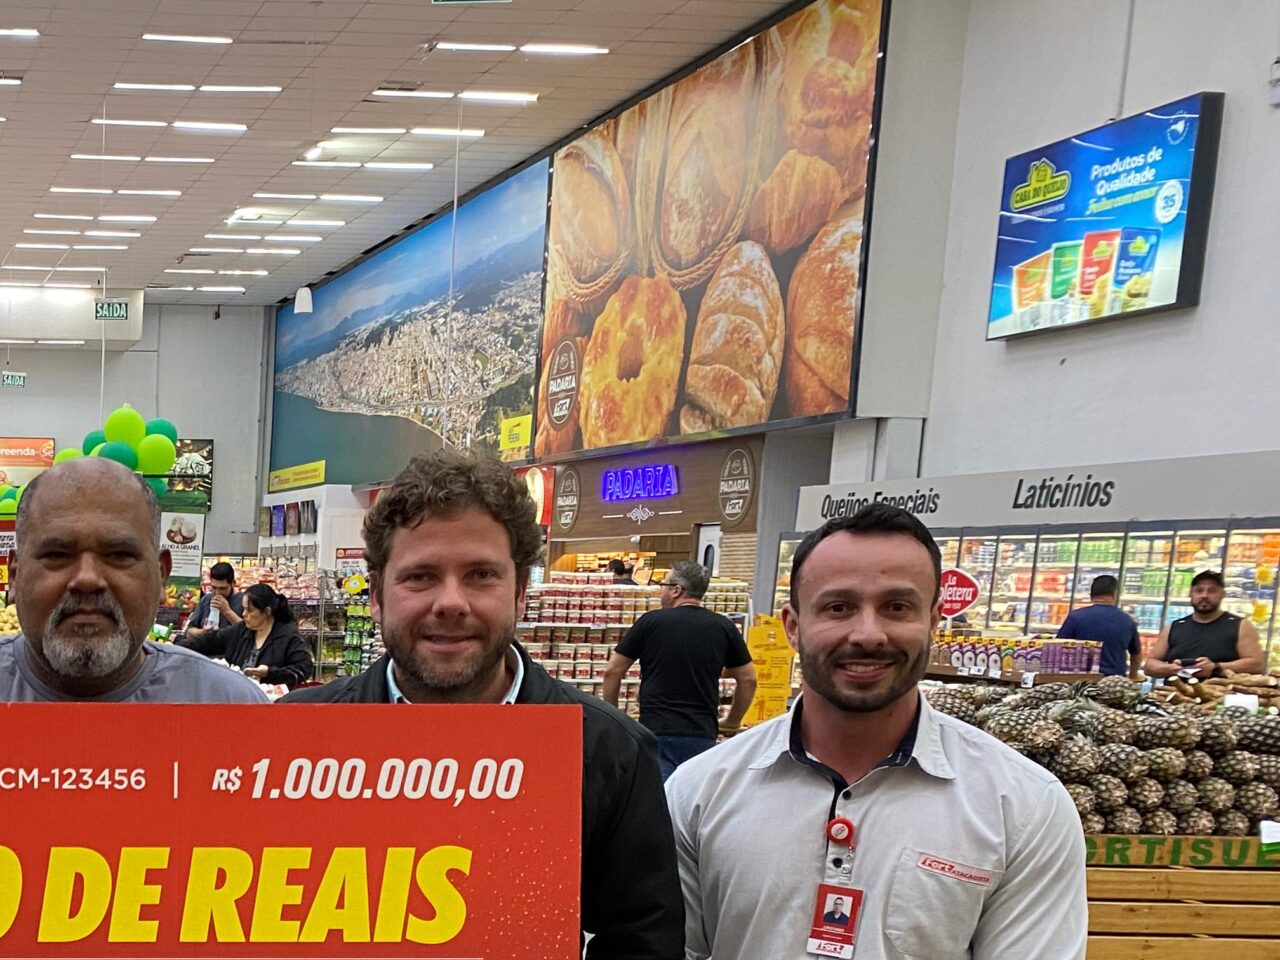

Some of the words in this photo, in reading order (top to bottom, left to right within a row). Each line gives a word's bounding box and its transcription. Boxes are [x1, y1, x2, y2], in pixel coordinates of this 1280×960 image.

[1090, 153, 1144, 180] Produtos
[1147, 146, 1163, 163] de
[1095, 167, 1157, 195] Qualidade
[1162, 195, 1176, 210] 35
[96, 302, 127, 317] SAÍDA
[3, 375, 24, 387] SAÍDA
[549, 374, 576, 394] PADARIA
[601, 463, 679, 501] PADARIA
[720, 480, 750, 492] PADARIA
[1012, 474, 1115, 510] Laticínios
[948, 574, 957, 585] La
[211, 766, 243, 793] R$
[251, 758, 524, 807] 1.000.000,00
[924, 858, 951, 872] Fort
[37, 846, 170, 943] DE
[179, 845, 473, 945] REAIS
